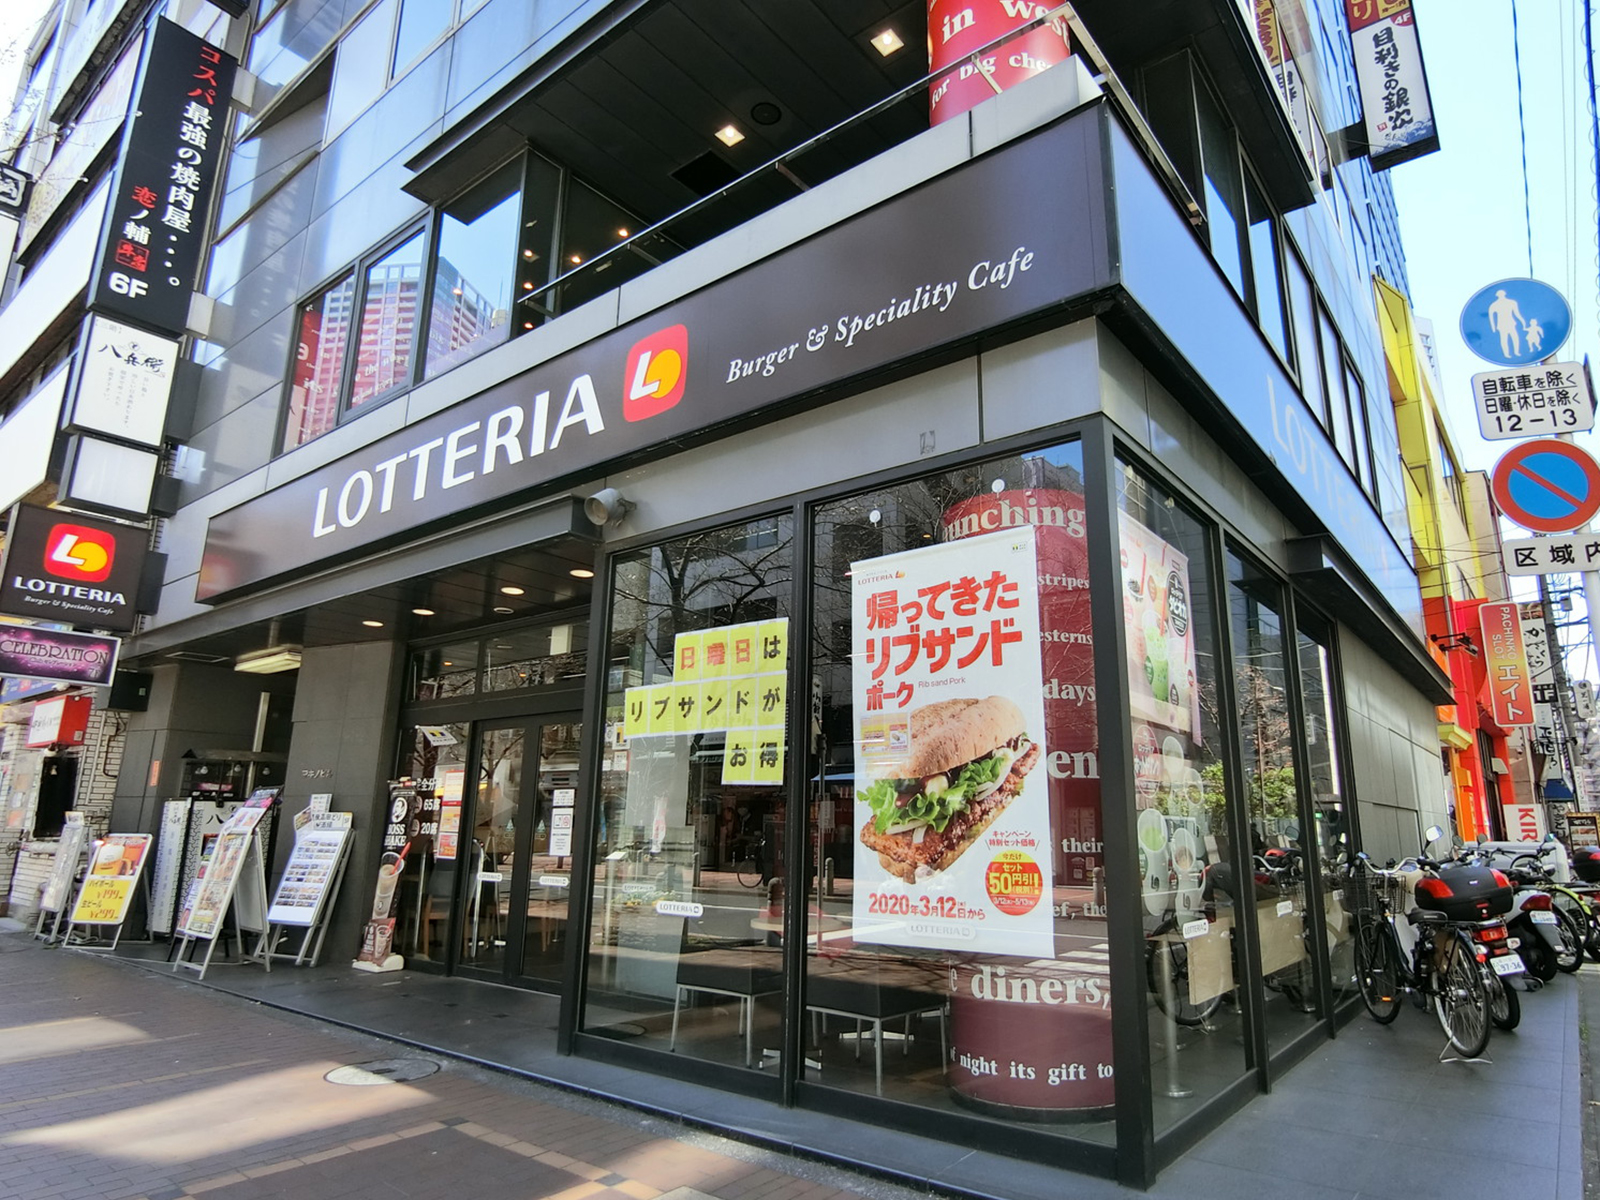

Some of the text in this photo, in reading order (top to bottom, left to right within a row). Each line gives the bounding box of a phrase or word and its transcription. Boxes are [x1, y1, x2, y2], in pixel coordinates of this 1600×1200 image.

[941, 7, 976, 45] in
[1394, 12, 1411, 25] 4F
[931, 78, 950, 111] for
[1008, 52, 1053, 72] che
[1372, 26, 1414, 132] 目利きの銀次
[108, 271, 149, 299] 6F
[725, 246, 1035, 384] Burger & Speciality Cafe
[1481, 370, 1577, 396] 自転車を除く
[312, 373, 606, 539] LOTTERIA
[1513, 541, 1600, 568] 区域内
[13, 575, 127, 606] LOTTERIA
[858, 573, 894, 586] LOTTERIA
[1037, 573, 1091, 591] stripes
[24, 595, 52, 606] Burger
[61, 600, 97, 614] Speciality
[97, 604, 116, 616] Cafe
[866, 570, 1020, 631] 帰ってきた
[1491, 633, 1505, 660] SLOT
[1498, 606, 1520, 660] PACHINKO
[0, 639, 109, 665] CELEBRATION
[680, 635, 782, 671] 日曜日は
[865, 617, 1023, 681] リブサンド
[866, 681, 915, 711] ポーク
[1497, 664, 1524, 722] エイト
[1533, 689, 1556, 701] 1F
[729, 741, 779, 769] お得
[988, 838, 1036, 847] 特別セット価格
[992, 830, 1032, 838] キャンペーン
[1061, 837, 1104, 853] their
[1002, 863, 1023, 873] セット
[868, 892, 987, 921] 2020年3月12日から
[910, 924, 961, 936] LOTTERIA
[970, 965, 1111, 1010] diners,
[959, 1052, 998, 1077] night
[1009, 1060, 1037, 1081] its
[1047, 1062, 1088, 1086] gift
[1096, 1062, 1114, 1079] to
